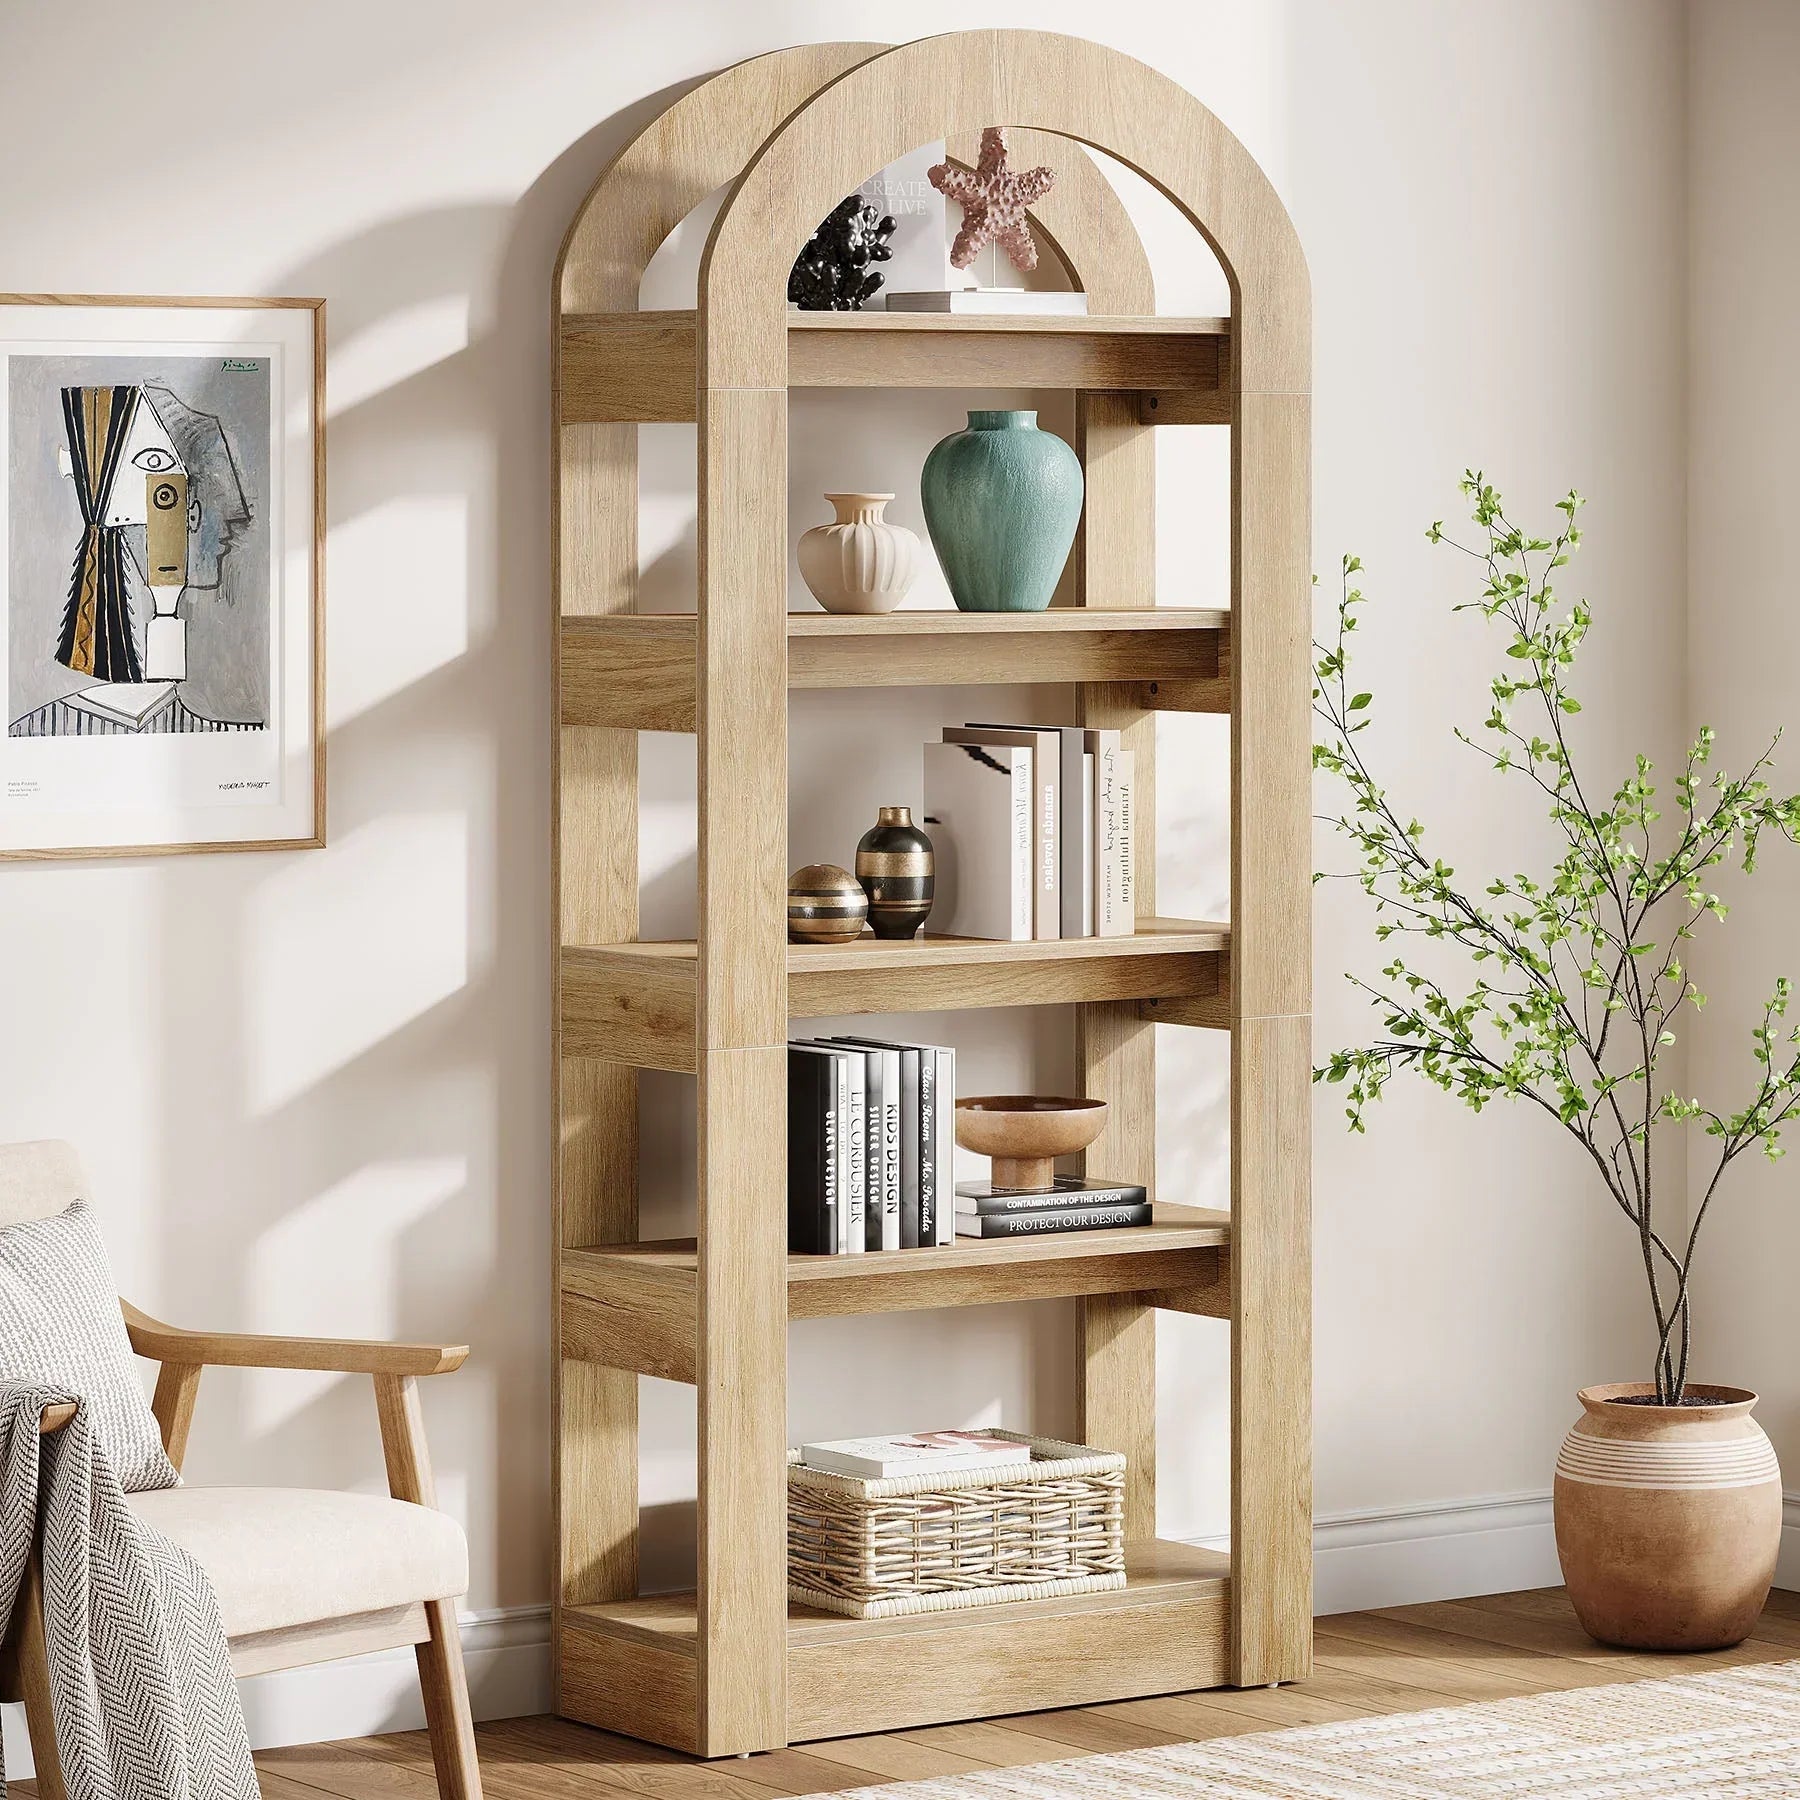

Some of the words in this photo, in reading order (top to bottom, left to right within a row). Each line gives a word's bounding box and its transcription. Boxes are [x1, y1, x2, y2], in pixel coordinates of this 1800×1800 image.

[861, 181, 927, 196] CREATE
[889, 199, 927, 215] LIVE
[850, 1091, 863, 1113] LE
[922, 1066, 933, 1100] Class
[825, 1110, 836, 1152] BLACK
[869, 1105, 880, 1151] SILVER
[886, 1104, 898, 1145] KIDS
[922, 1104, 933, 1141] Room
[825, 1158, 836, 1206] DESIGN
[850, 1118, 863, 1225] CORBUSIER
[869, 1157, 880, 1204] DESIGN
[886, 1149, 898, 1214] DESIGN
[922, 1157, 933, 1182] Ms.
[922, 1185, 933, 1232] Posada
[1006, 1198, 1068, 1209] CONTAMINATION
[1069, 1196, 1079, 1205] OF
[1079, 1195, 1094, 1204] THE
[1094, 1193, 1122, 1203] DESIGN
[1009, 1216, 1062, 1232] PROTECT
[1063, 1215, 1089, 1228] OUR
[1091, 1212, 1132, 1226] DESIGN
